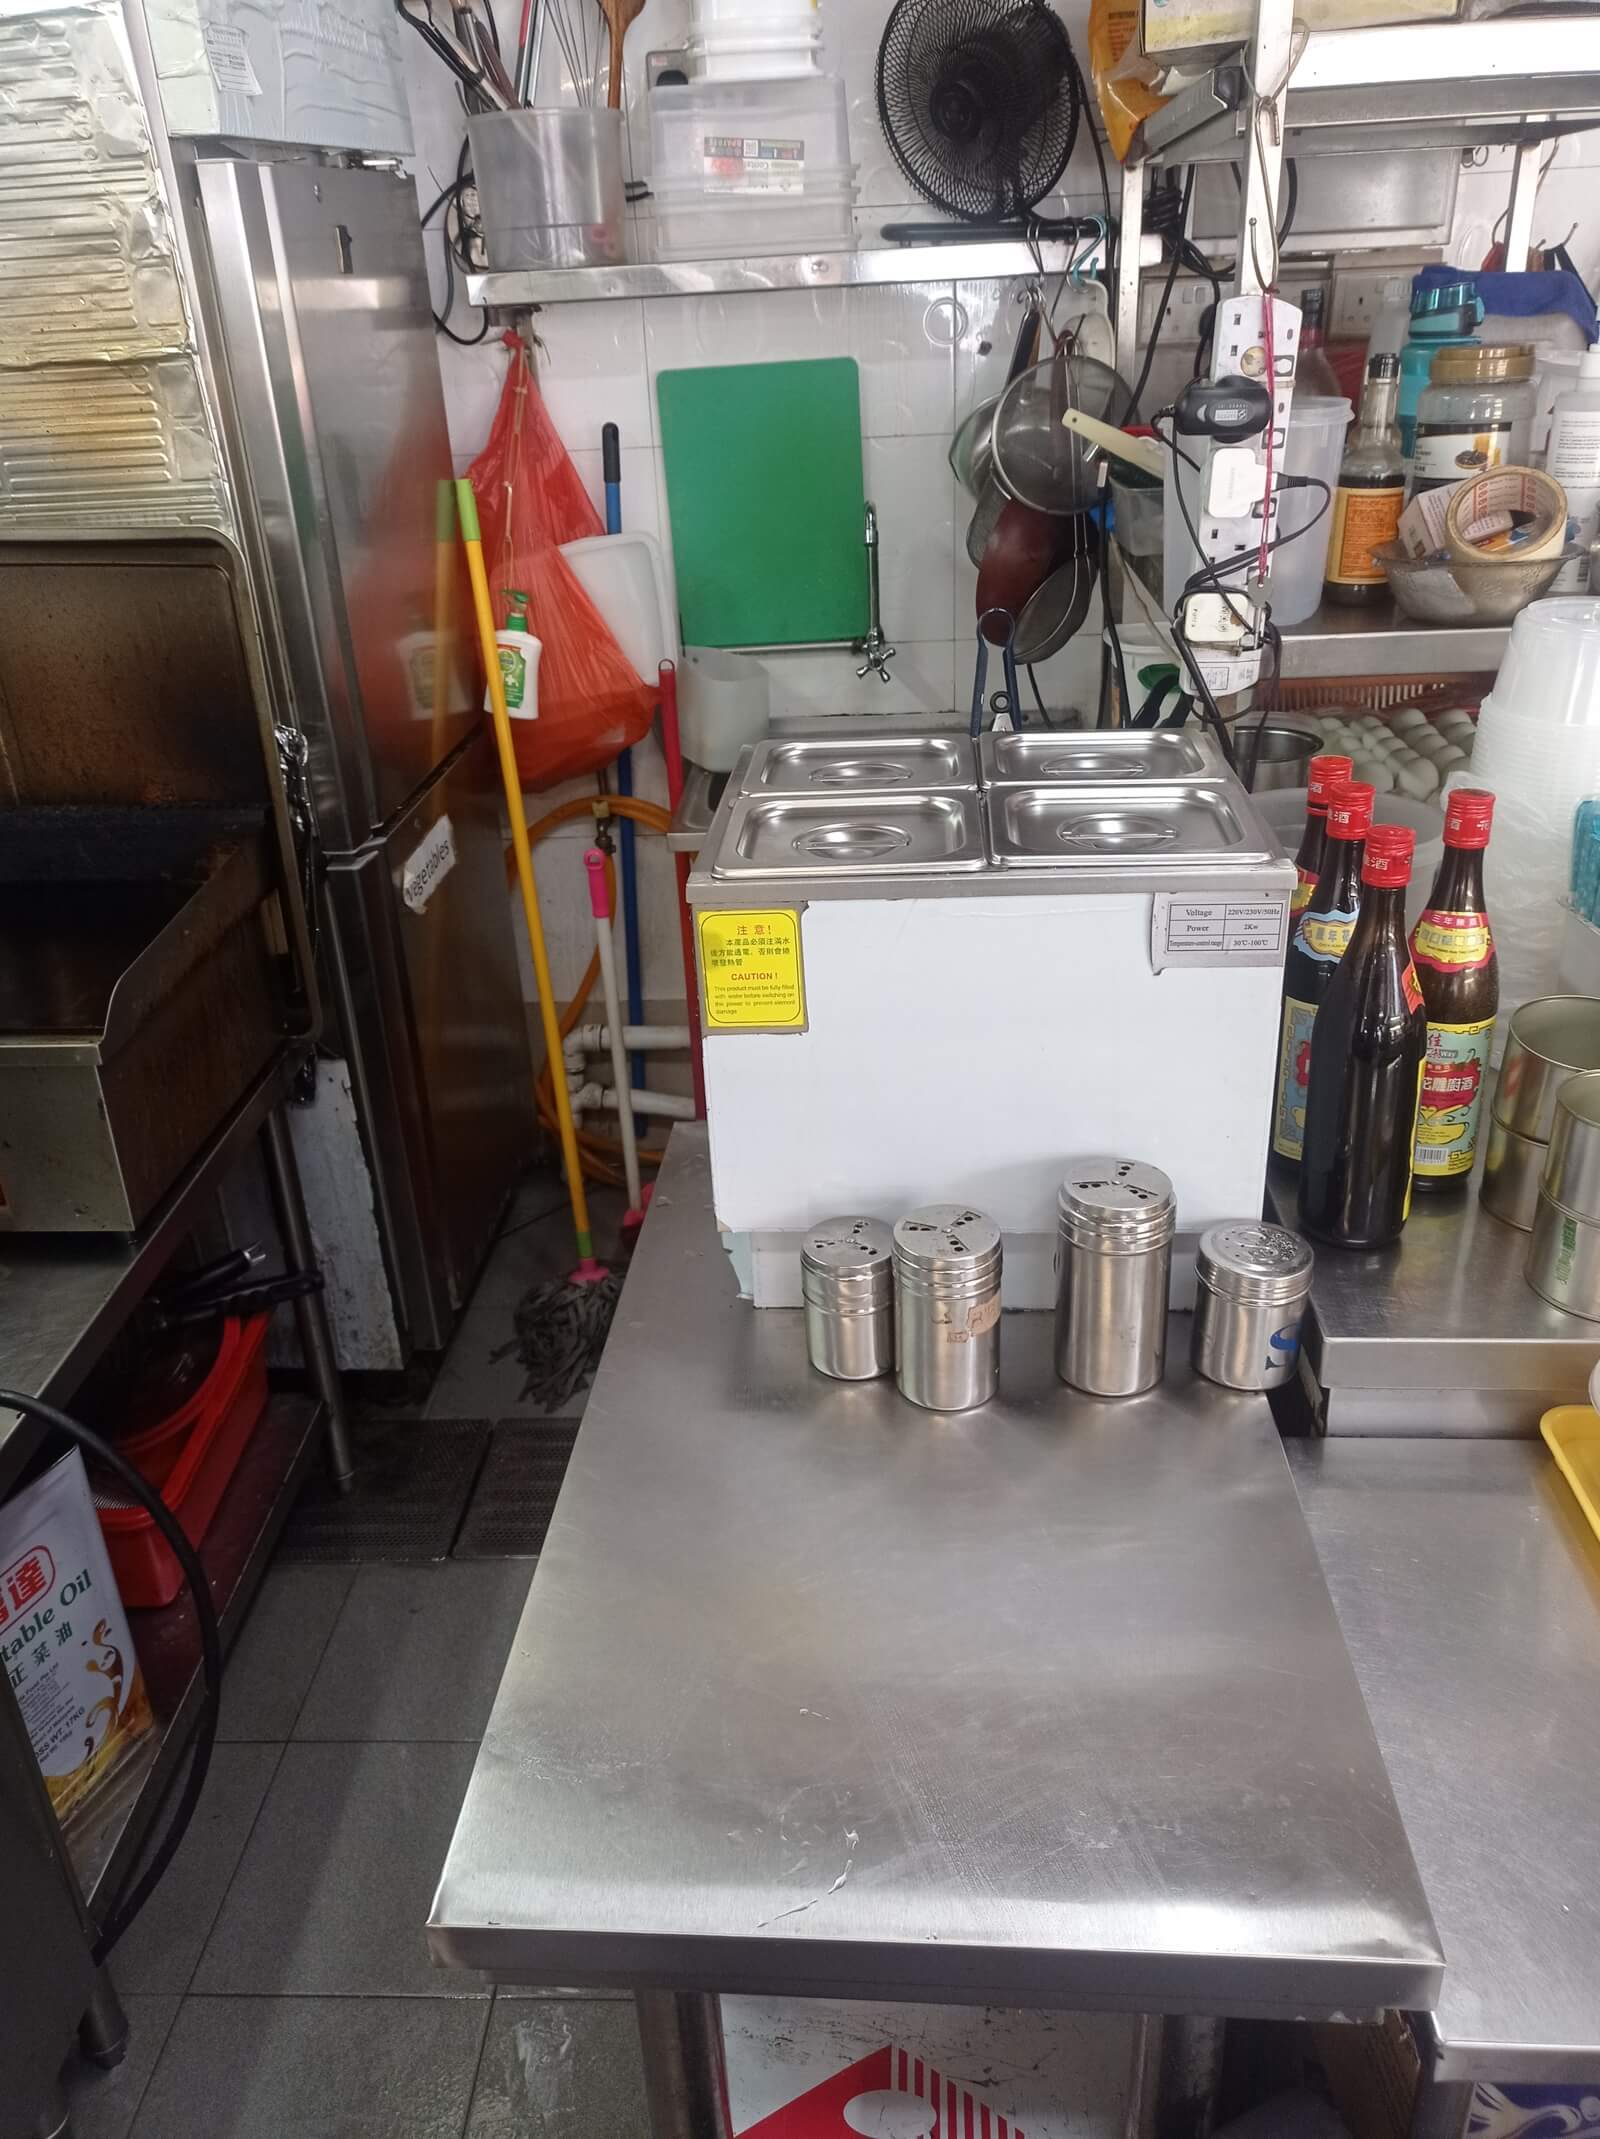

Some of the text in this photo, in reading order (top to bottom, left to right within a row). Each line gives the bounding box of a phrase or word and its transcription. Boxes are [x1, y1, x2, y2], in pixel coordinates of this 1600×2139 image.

[1185, 909, 1213, 918] Voltage
[1186, 924, 1210, 932] Power
[730, 973, 773, 981] CAUTION
[59, 1568, 92, 1607] Oil
